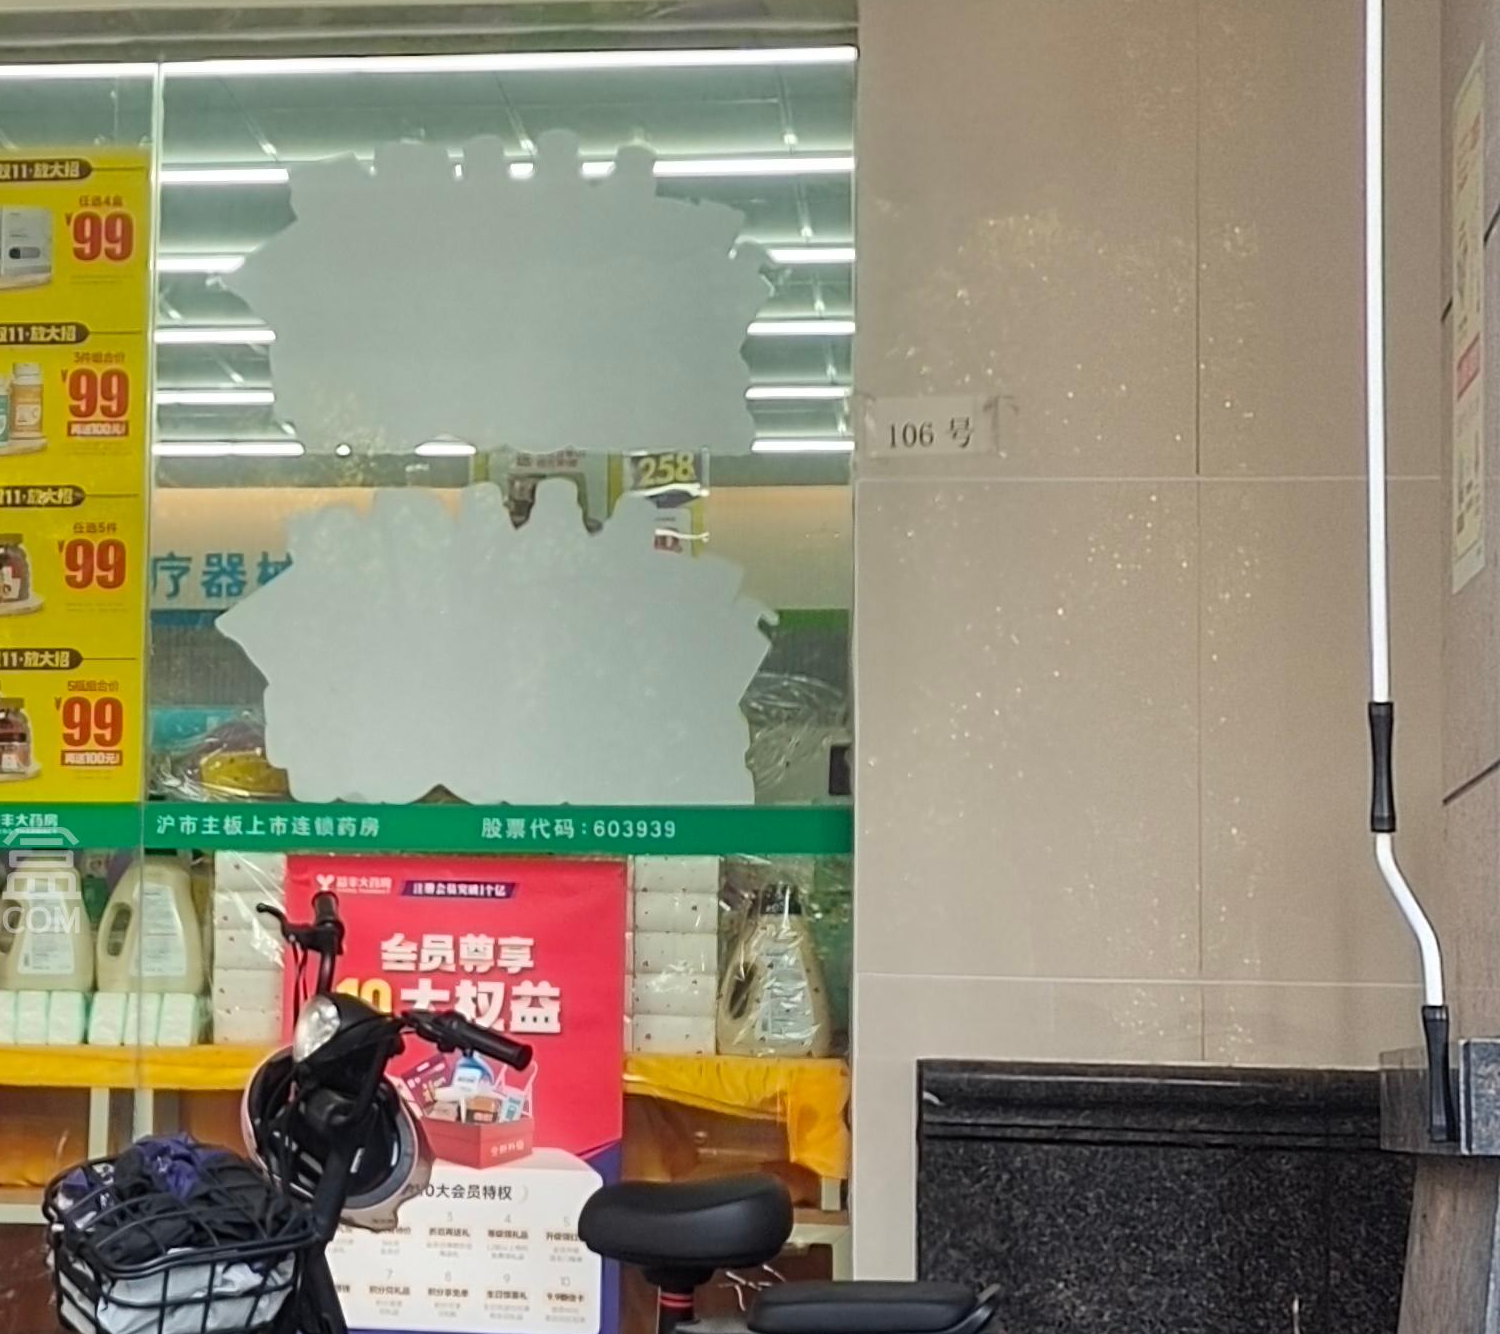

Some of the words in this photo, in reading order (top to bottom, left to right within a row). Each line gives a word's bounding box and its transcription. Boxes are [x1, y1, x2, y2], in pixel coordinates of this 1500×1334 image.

[638, 451, 696, 486] 258
[157, 814, 380, 837] 沪市主板上市连锁药房
[381, 933, 535, 973] 会员尊享
[400, 1182, 512, 1201] 10大会员特权
